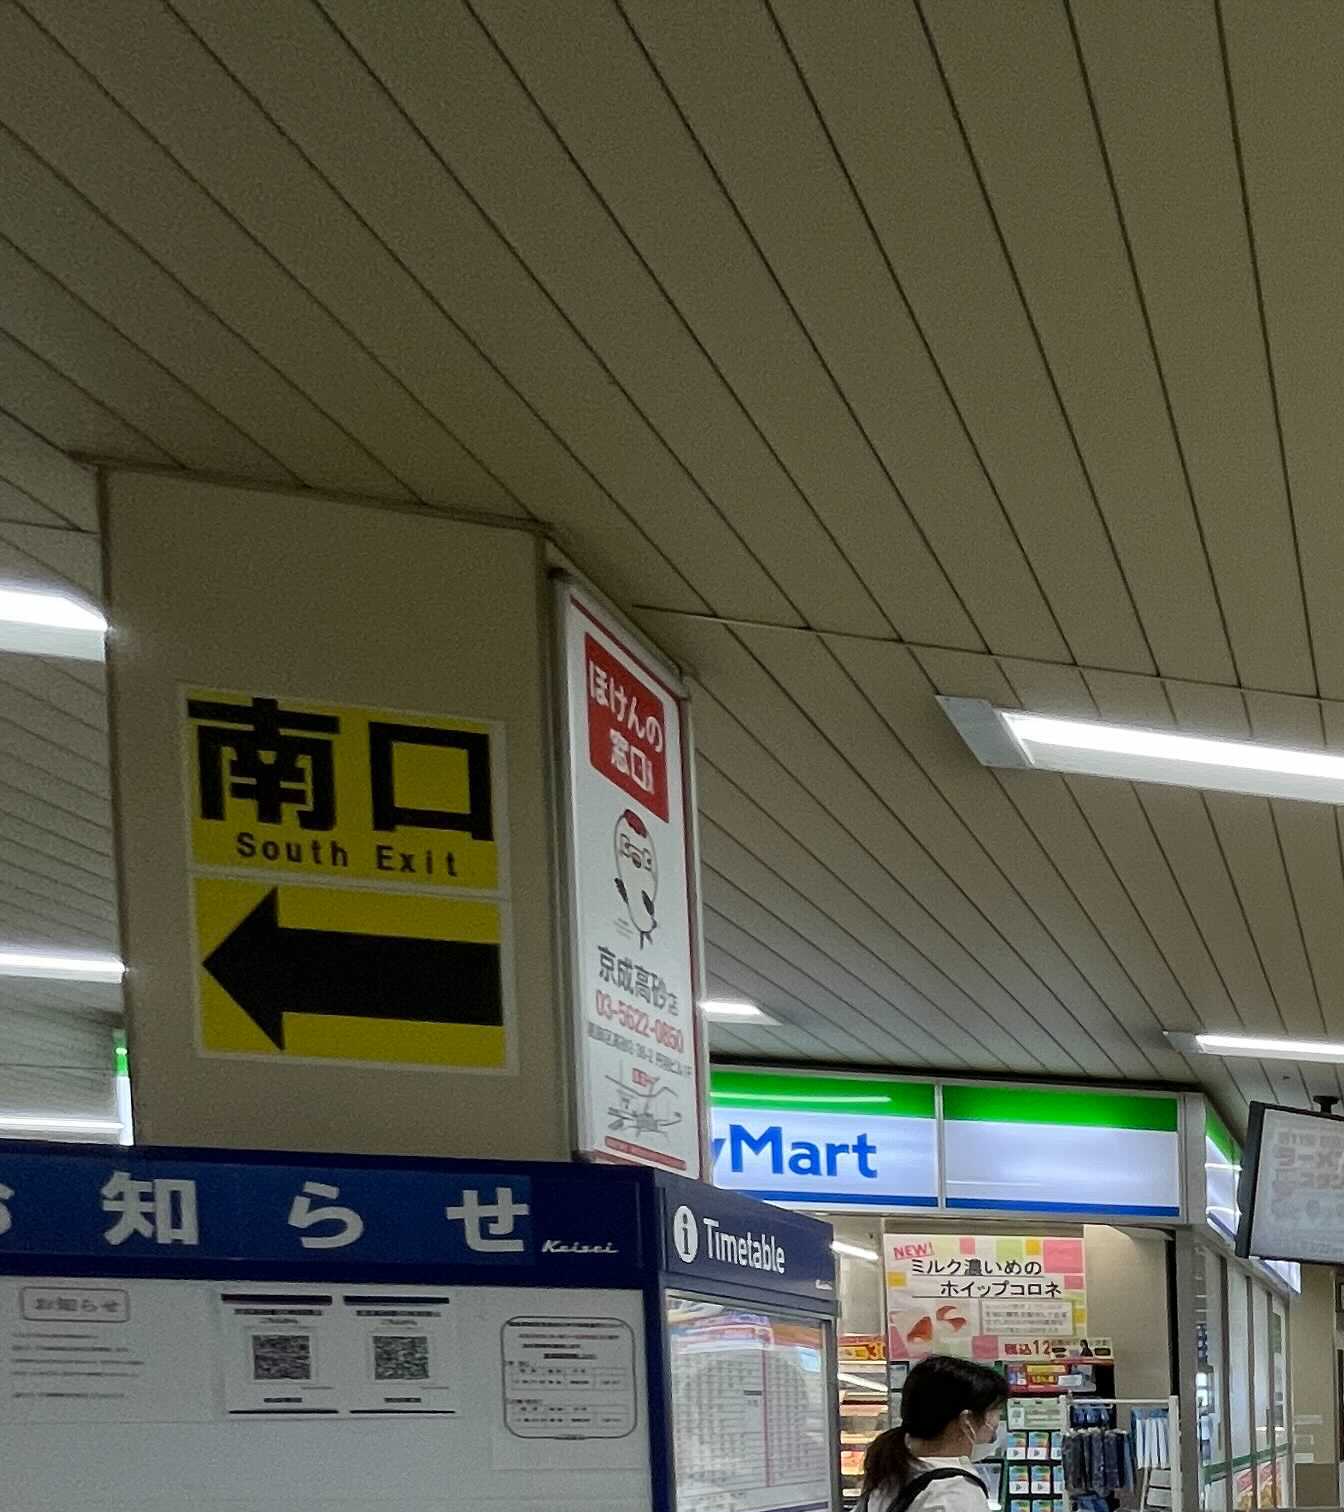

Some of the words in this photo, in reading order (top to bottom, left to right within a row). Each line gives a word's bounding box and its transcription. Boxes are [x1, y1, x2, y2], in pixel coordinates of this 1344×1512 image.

[589, 661, 663, 753] ほけんの
[187, 697, 494, 841] 南口
[609, 728, 650, 794] 窓口
[236, 832, 348, 867] South
[376, 844, 457, 876] Exit
[541, 1240, 619, 1253] Keisei
[704, 1218, 785, 1274] Timetable
[893, 1242, 934, 1258] NEW!
[912, 1258, 1042, 1276] ミルク濃いめの
[940, 1280, 1062, 1297] ホイップコロネ
